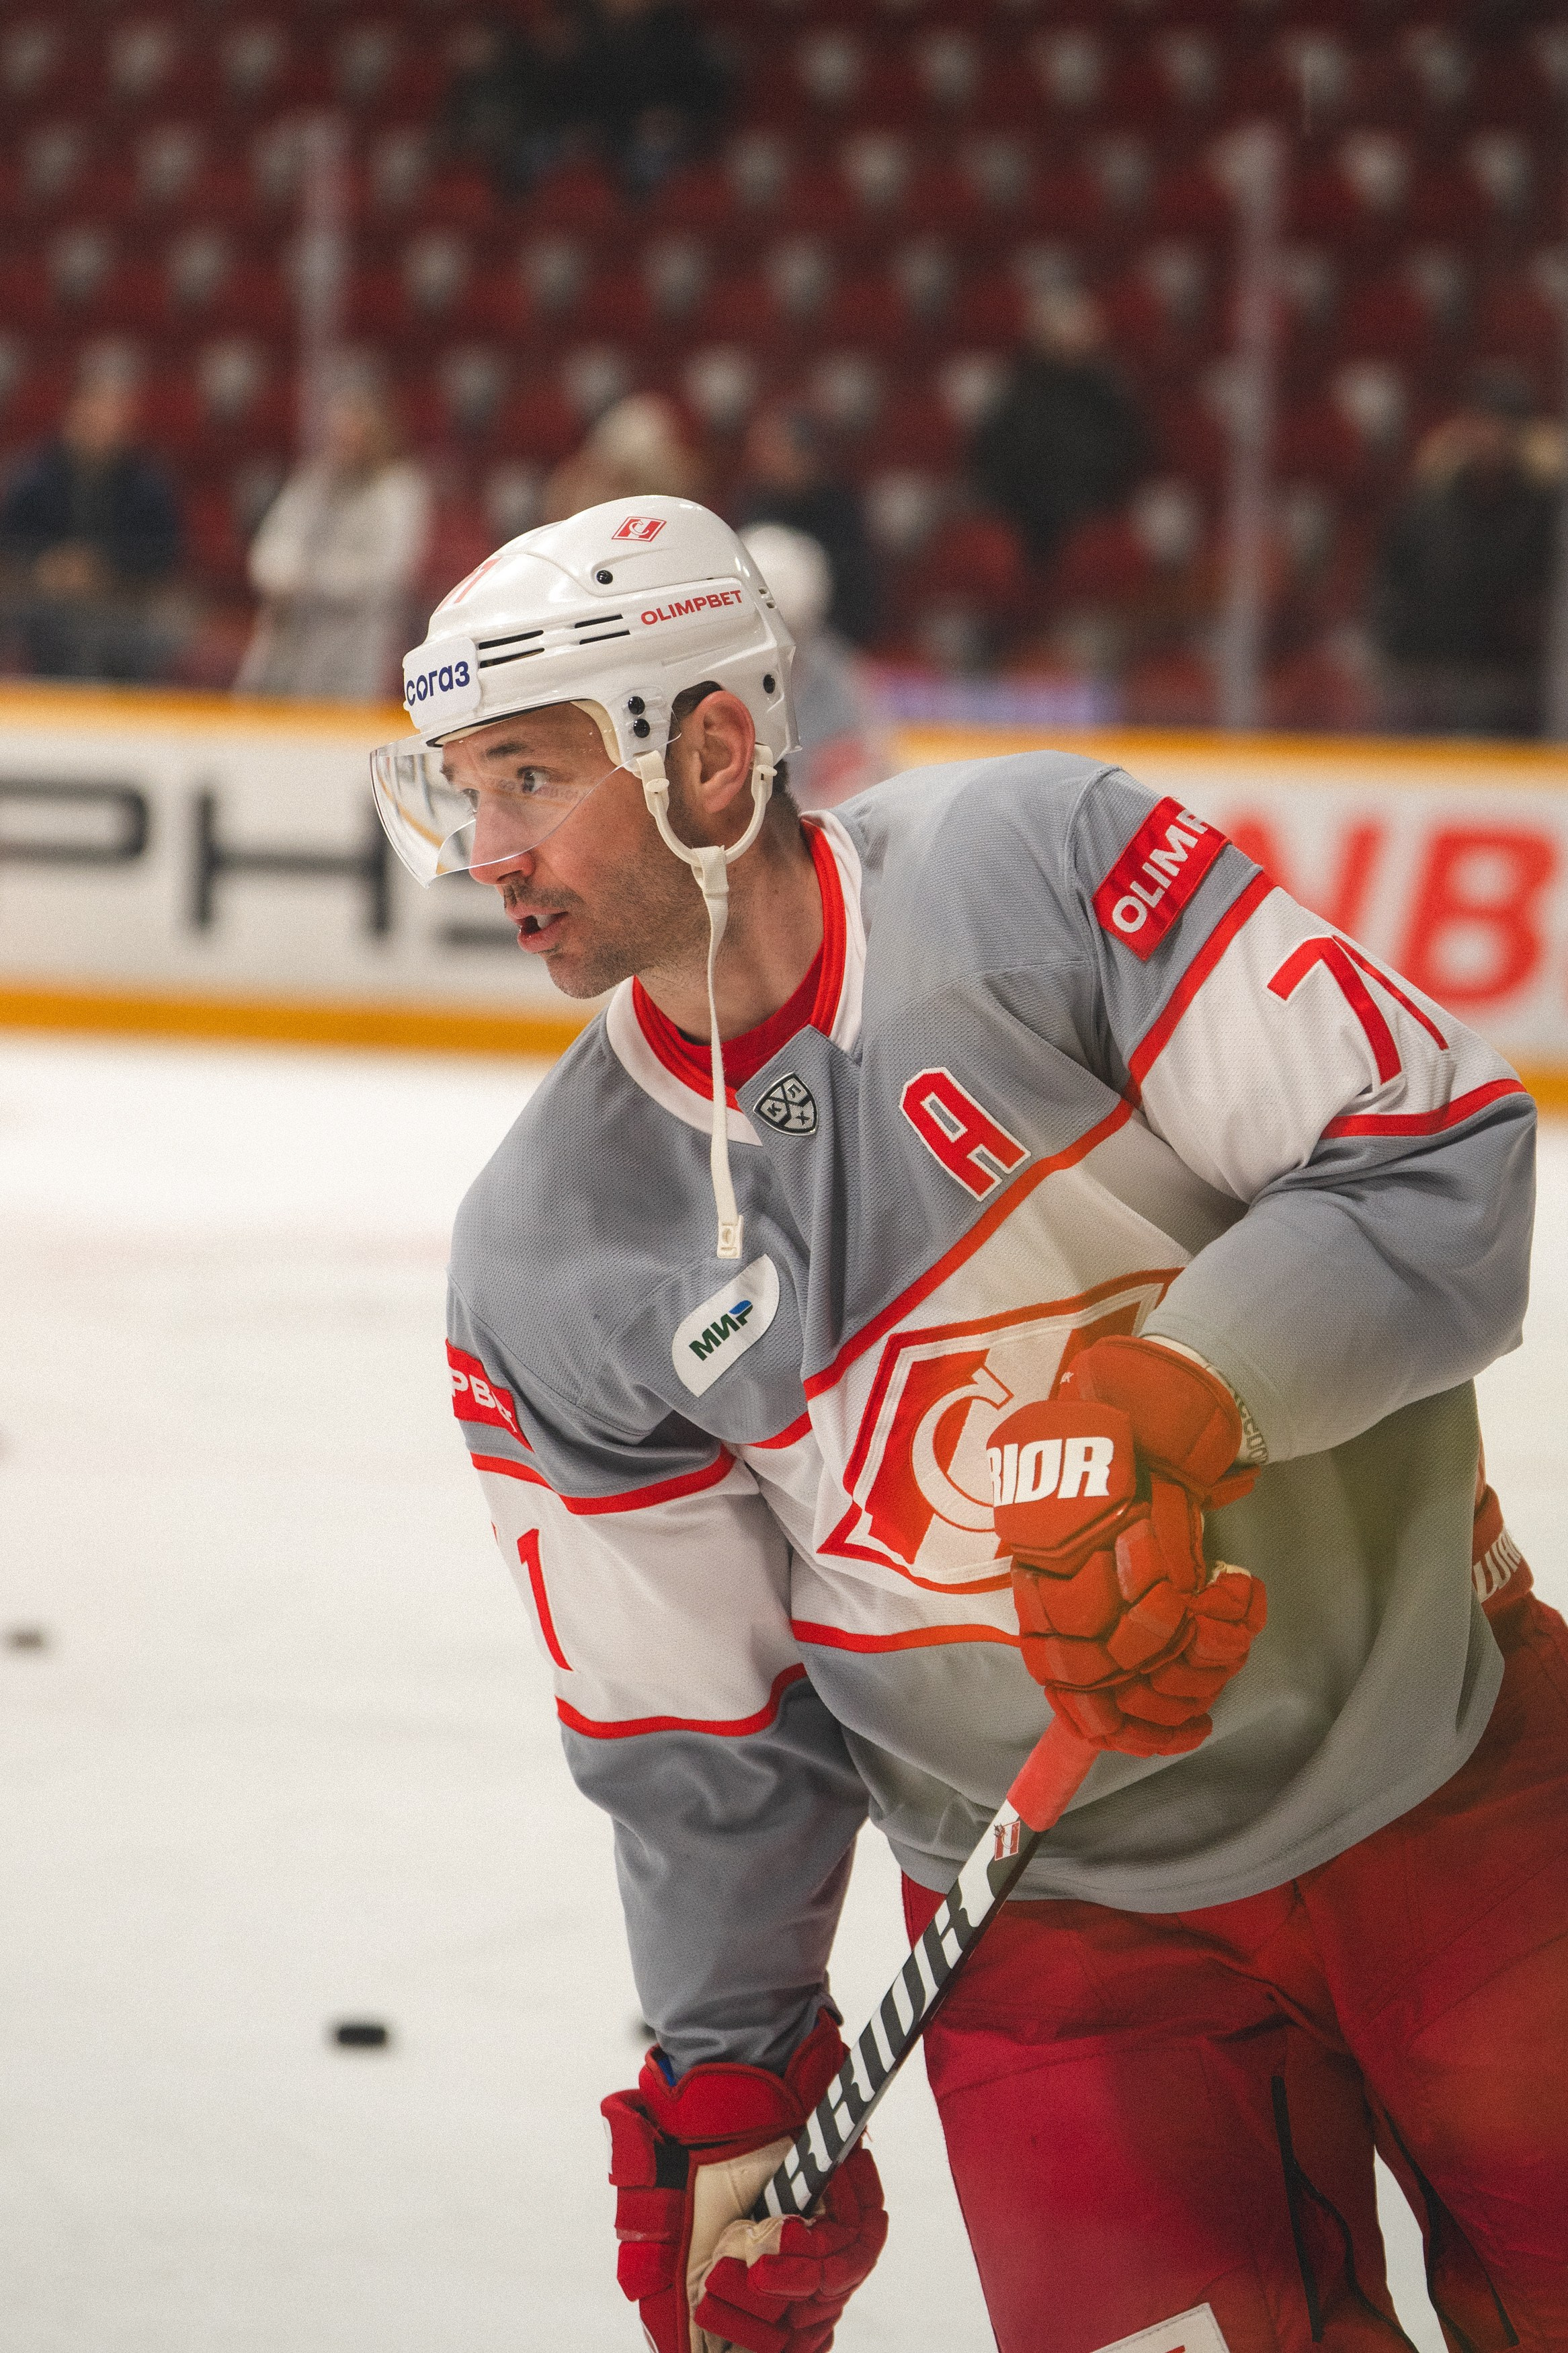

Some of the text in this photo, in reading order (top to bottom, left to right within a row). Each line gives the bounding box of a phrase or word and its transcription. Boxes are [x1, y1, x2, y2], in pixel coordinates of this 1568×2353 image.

[641, 590, 743, 625] OLIMPBET
[407, 661, 470, 707] согаз
[899, 1067, 1032, 1202] A
[689, 1300, 753, 1361] МИР
[754, 1874, 983, 2219] RRIOR
